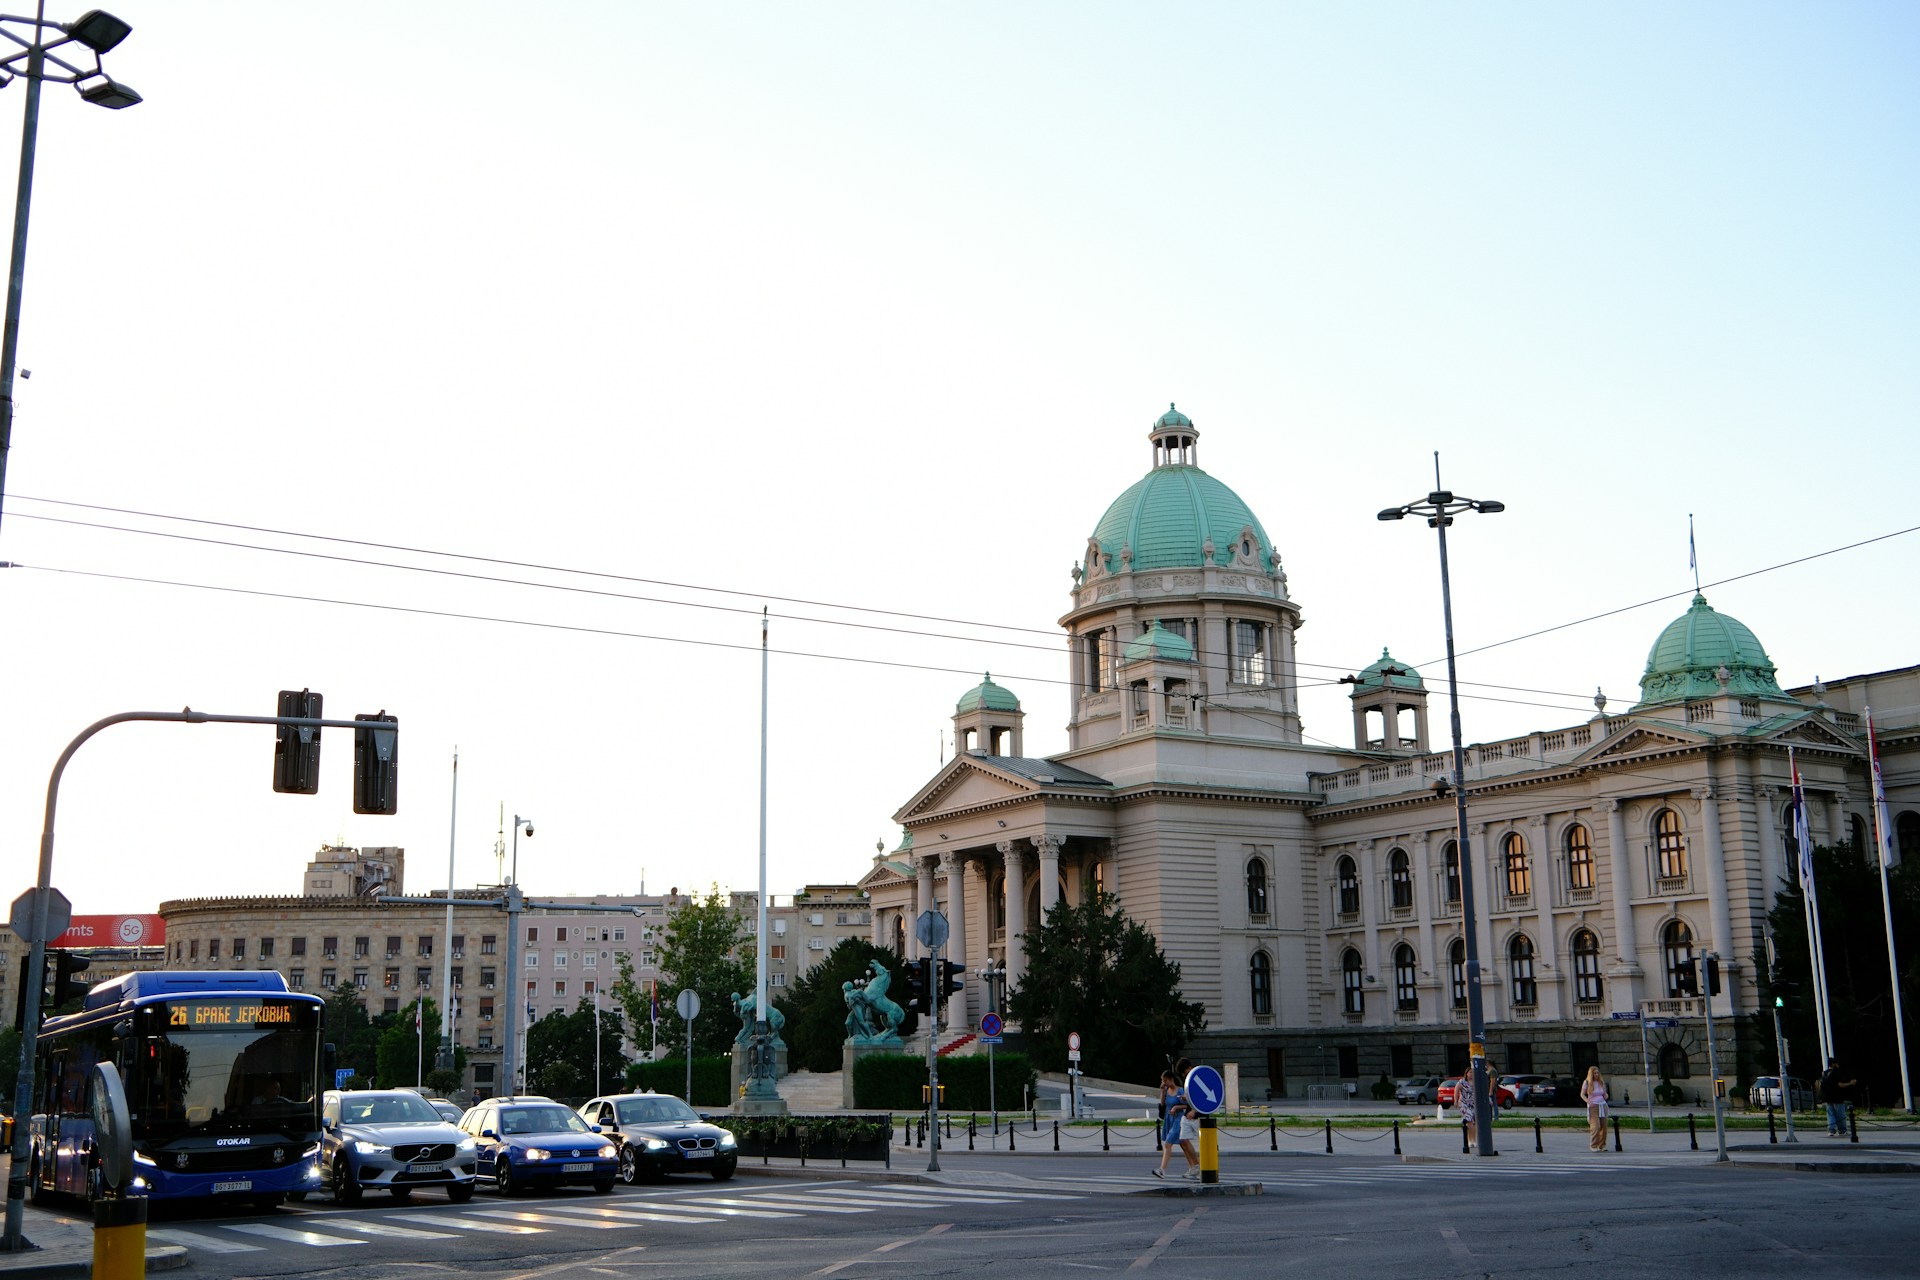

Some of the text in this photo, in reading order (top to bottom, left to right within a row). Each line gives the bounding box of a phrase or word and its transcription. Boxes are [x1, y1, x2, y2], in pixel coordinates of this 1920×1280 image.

[66, 924, 94, 936] mts
[123, 924, 140, 936] 5G
[170, 1006, 187, 1025] 26
[216, 1138, 250, 1146] OTOKAR
